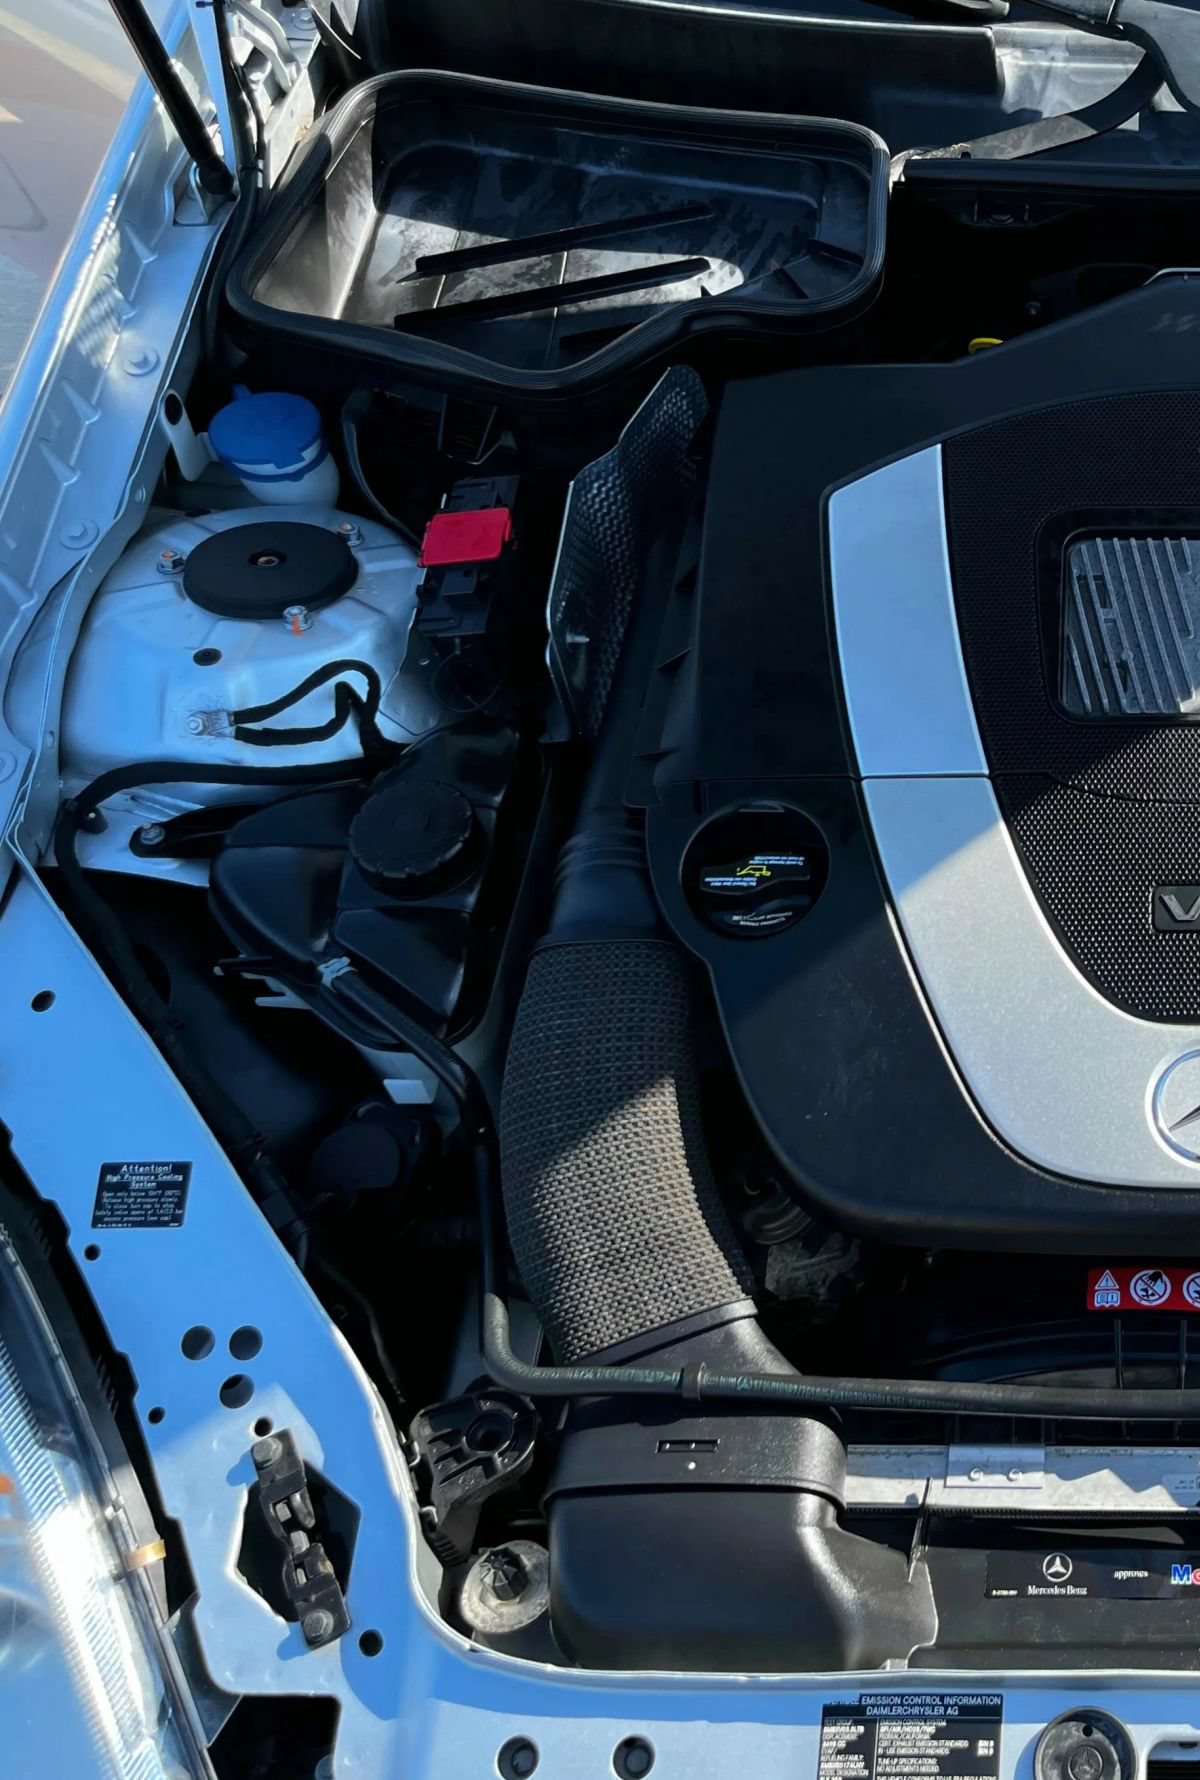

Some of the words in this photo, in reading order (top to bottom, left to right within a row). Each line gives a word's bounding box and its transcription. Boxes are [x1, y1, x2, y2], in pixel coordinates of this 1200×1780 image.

[122, 1164, 172, 1172] Attention!
[1114, 1570, 1148, 1580] approves
[1028, 1585, 1066, 1595] Mercedes
[861, 1696, 902, 1704] EMISSION
[903, 1696, 942, 1704] CONTROL
[944, 1696, 1001, 1705] INFORMATION
[866, 1706, 944, 1715] DAIMLERCHRYSLER
[946, 1706, 958, 1715] AG
